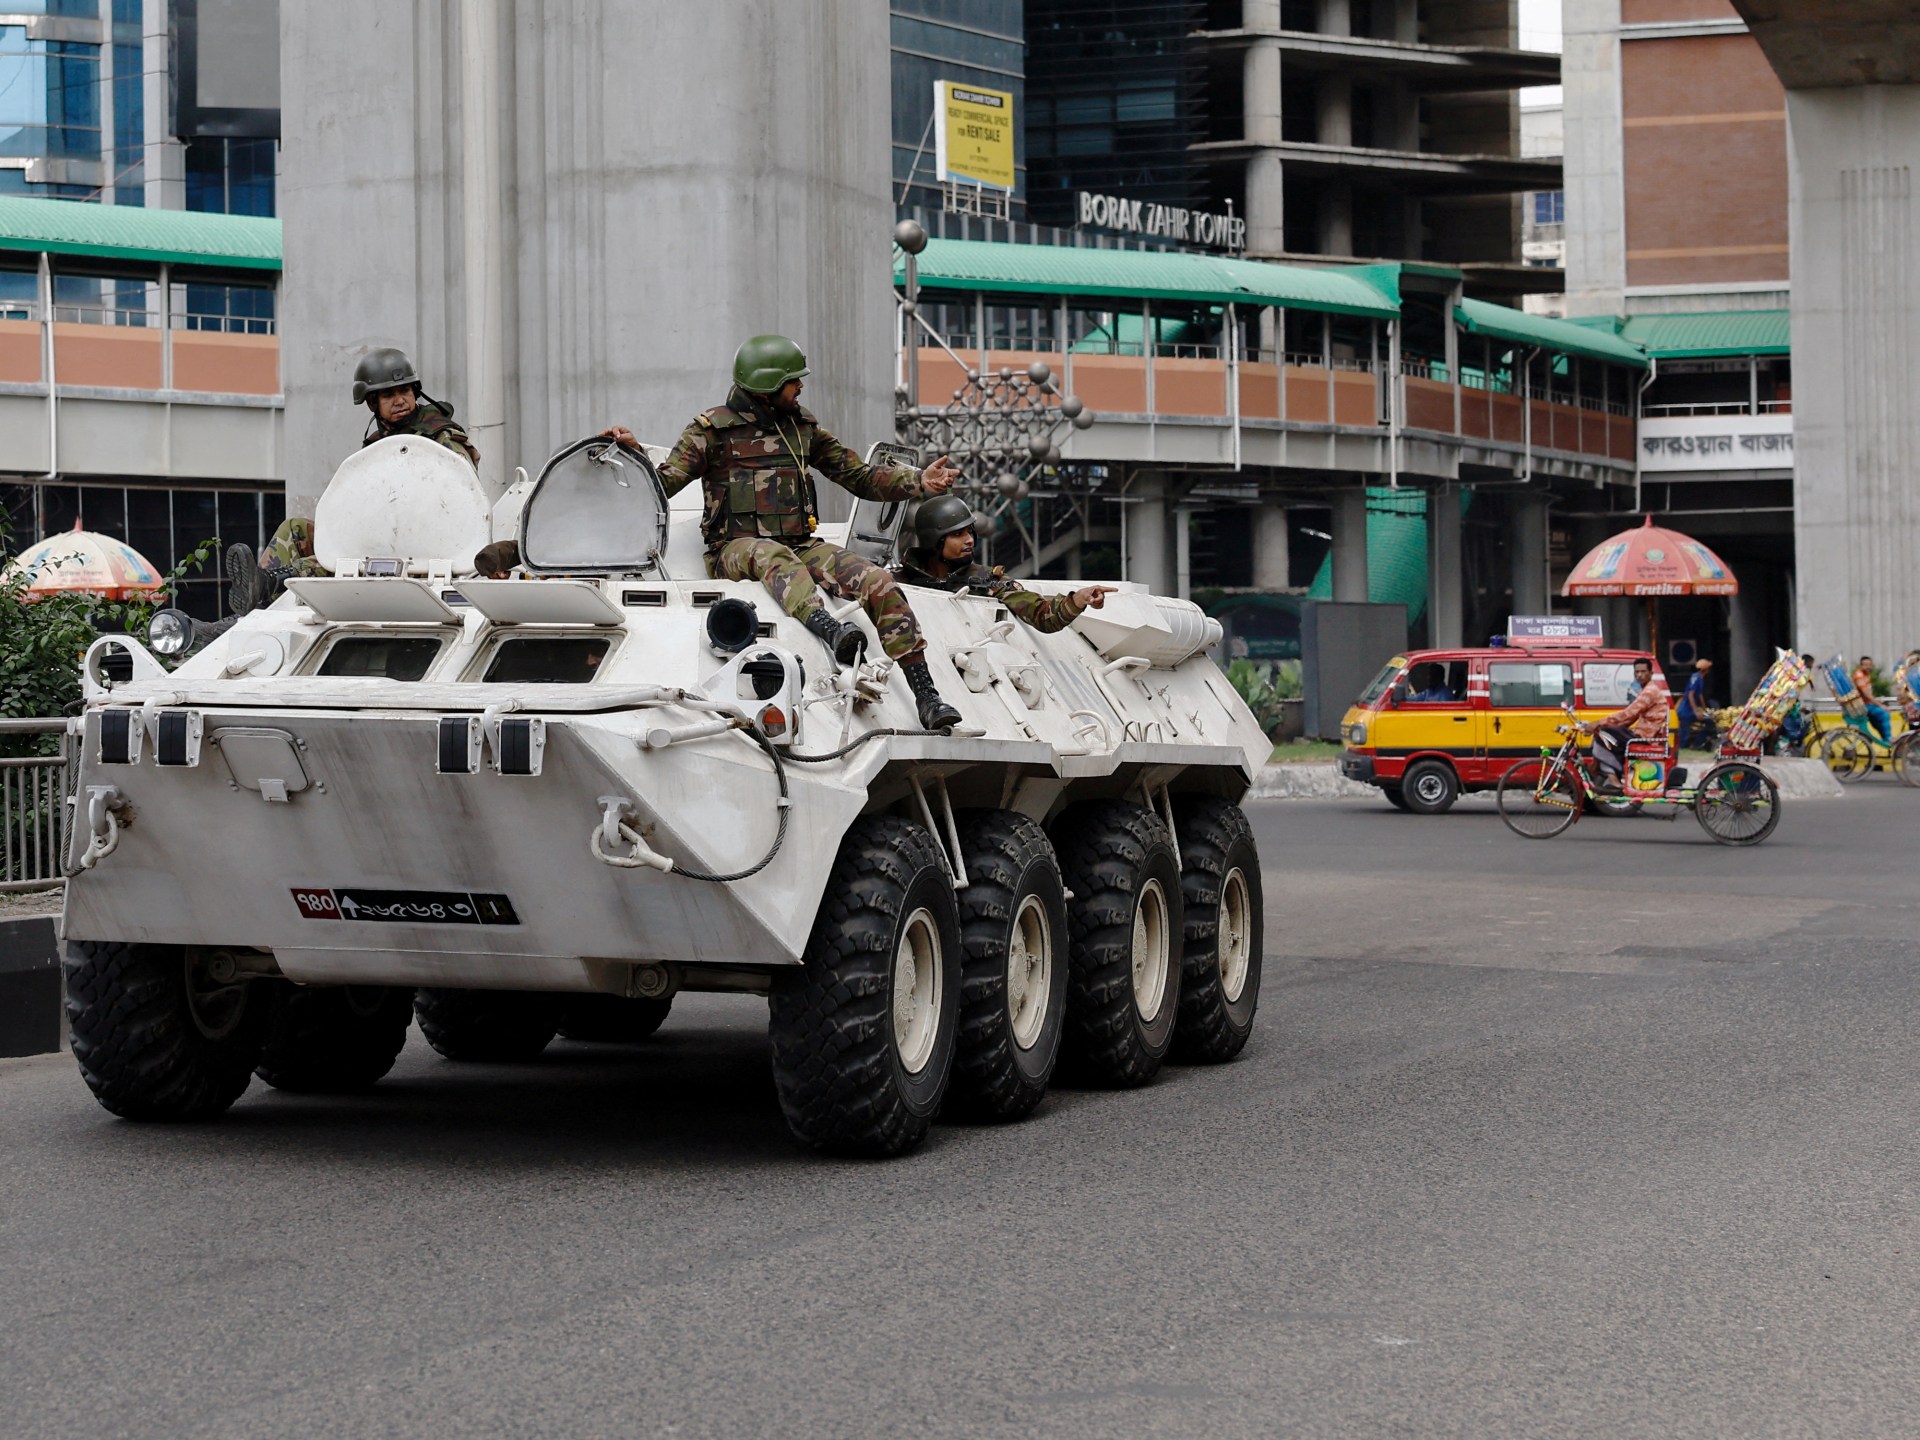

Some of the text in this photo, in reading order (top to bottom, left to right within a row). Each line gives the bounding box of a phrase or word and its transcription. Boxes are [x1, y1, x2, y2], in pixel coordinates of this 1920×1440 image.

[963, 110, 992, 124] COMMERCIAL
[993, 115, 1009, 127] SPACE
[1079, 191, 1246, 249] BORAK ZAHIR TOWER
[1642, 435, 1733, 457] কারওয়ান
[1634, 582, 1682, 596] Frutika
